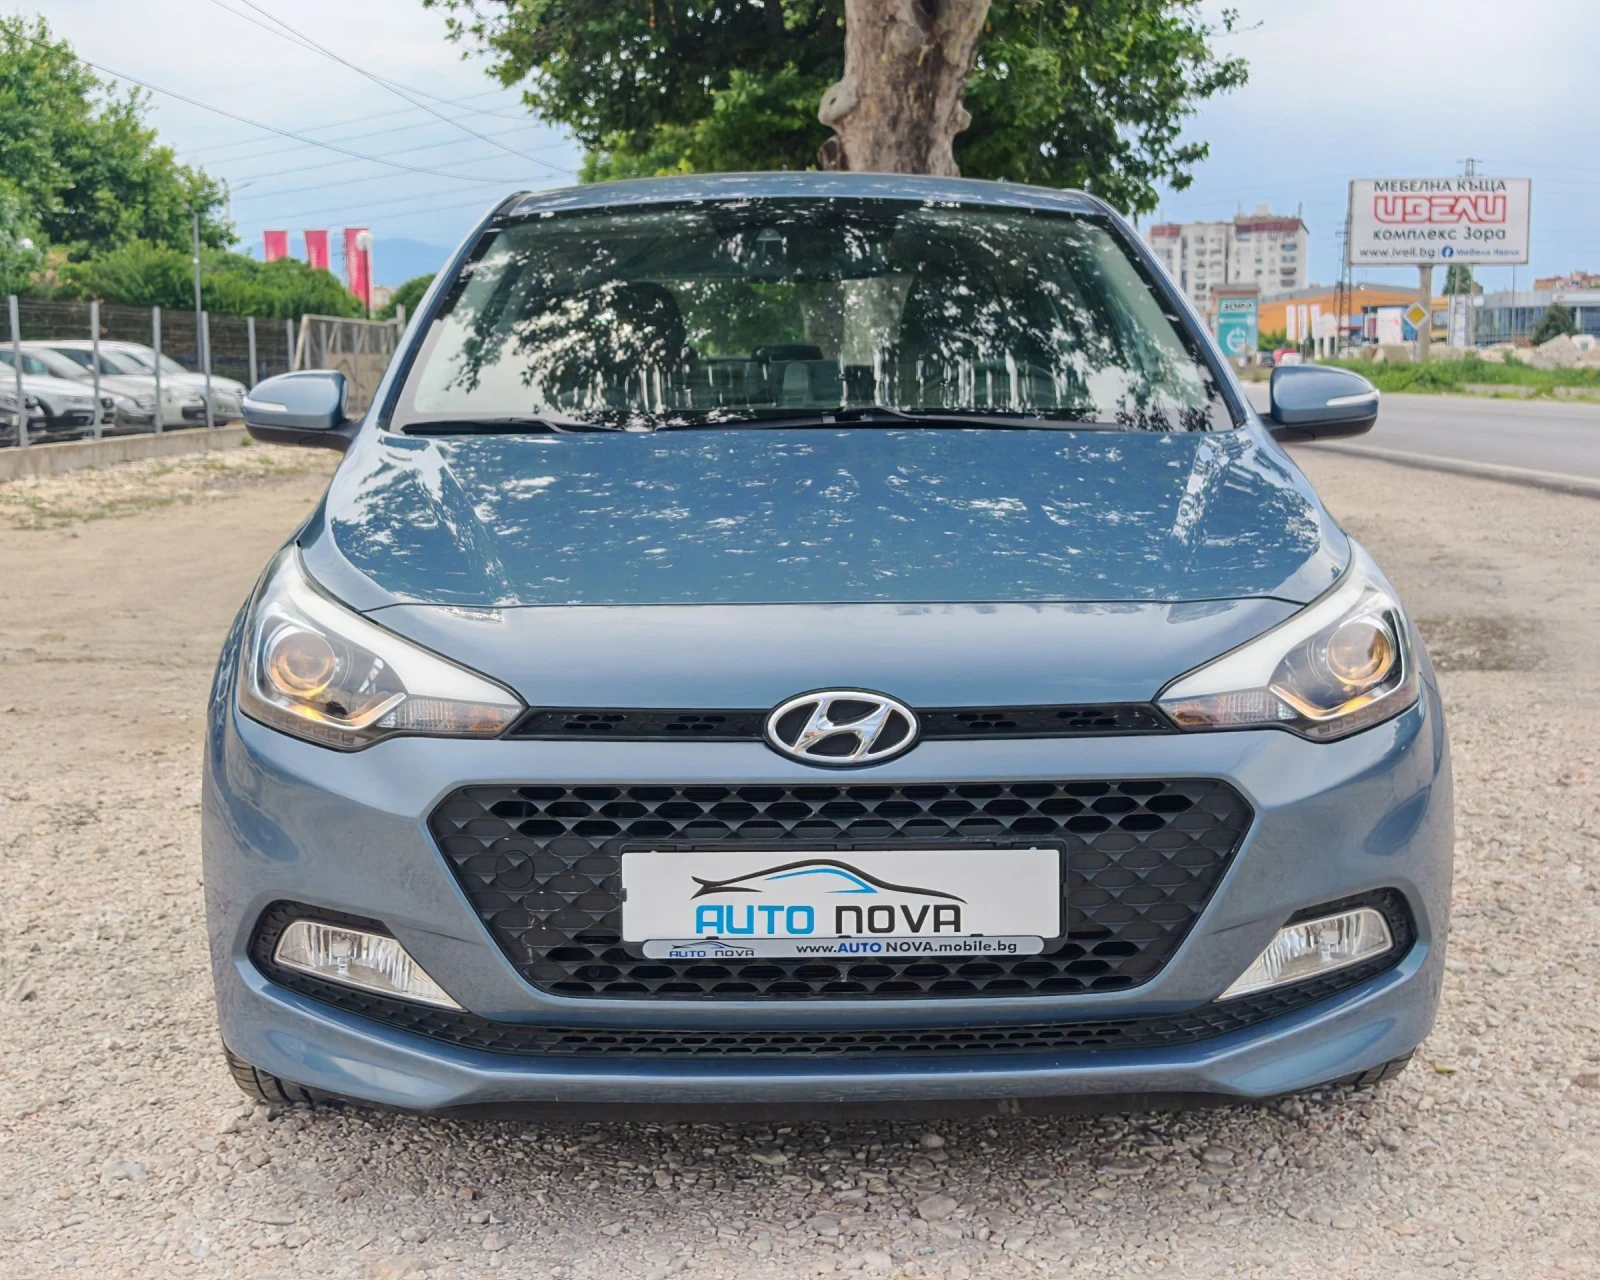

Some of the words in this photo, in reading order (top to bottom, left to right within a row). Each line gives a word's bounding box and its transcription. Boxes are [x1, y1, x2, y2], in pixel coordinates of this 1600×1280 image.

[1374, 180, 1452, 192] МЕБЕЛНА
[1457, 180, 1506, 193] КЪЩА
[1464, 227, 1506, 242] Зора
[695, 904, 815, 935] AUTO
[835, 904, 962, 935] NOVA
[669, 950, 706, 958] AUTO
[714, 949, 755, 957] NOVA
